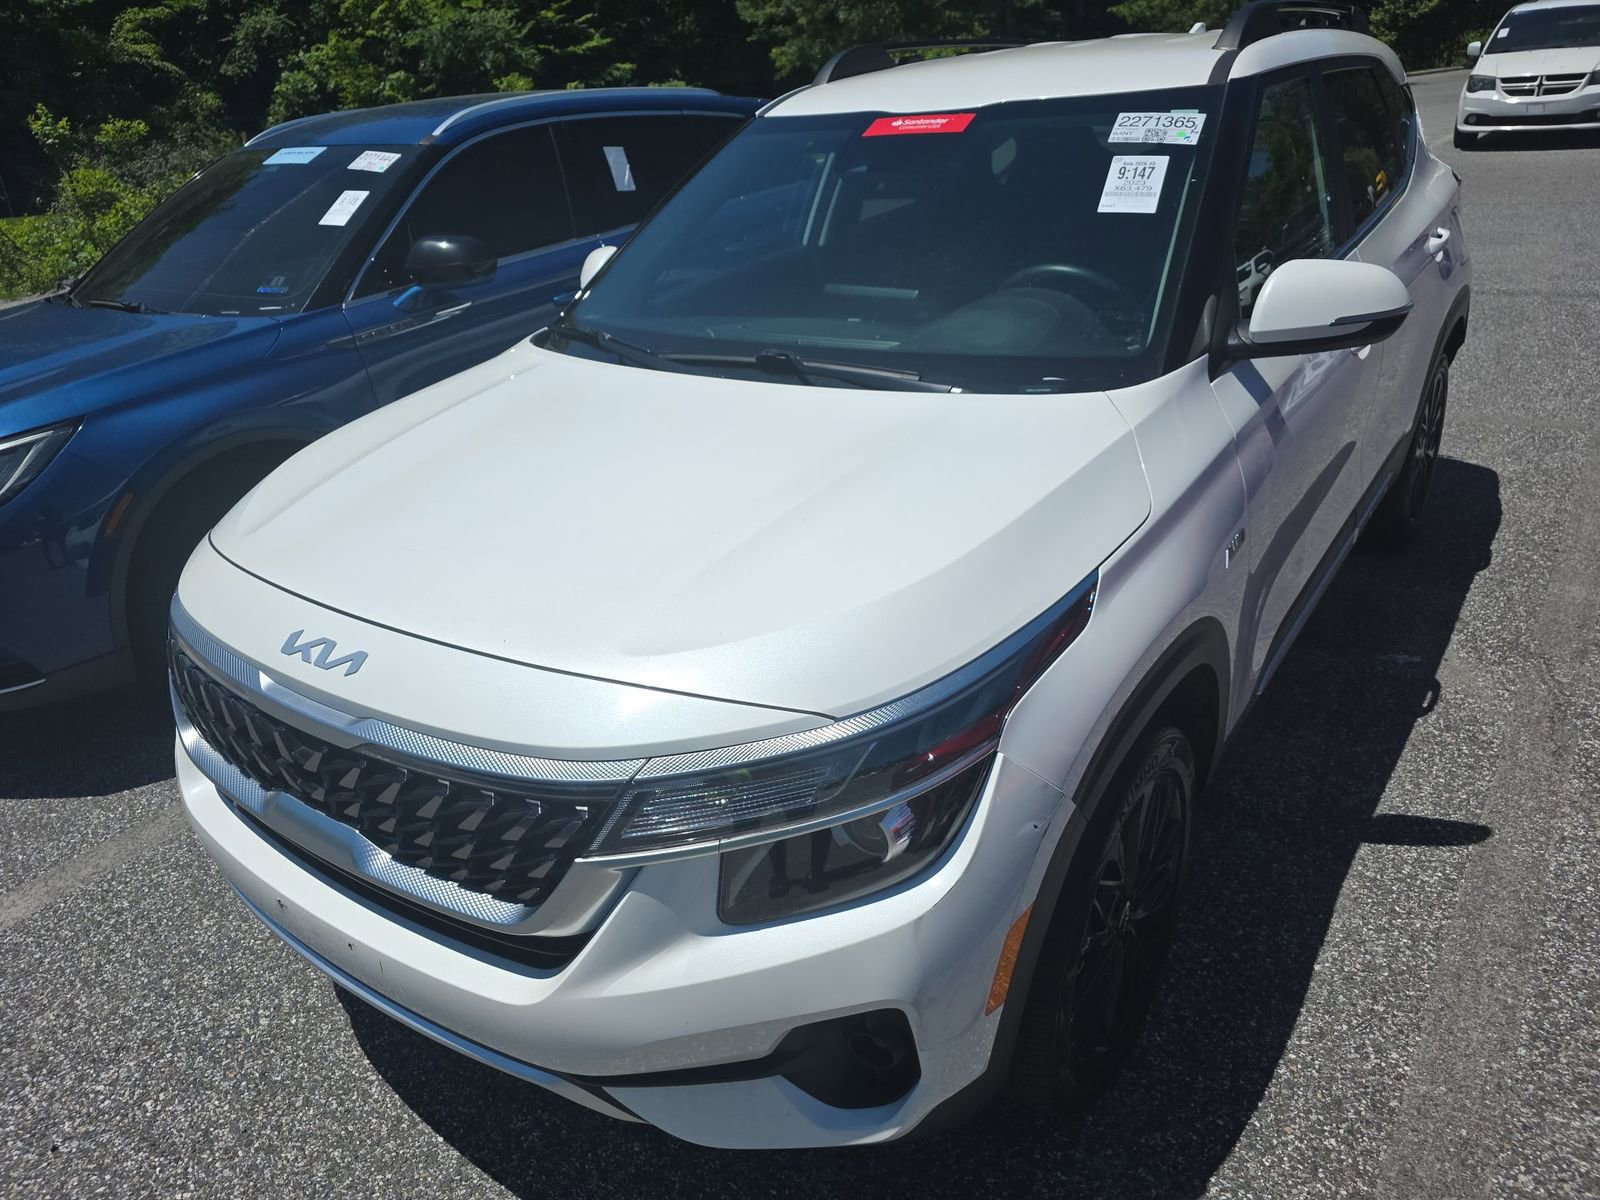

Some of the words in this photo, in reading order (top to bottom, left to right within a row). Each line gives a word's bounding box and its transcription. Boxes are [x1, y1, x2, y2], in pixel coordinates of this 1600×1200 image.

[902, 117, 950, 125] Santander
[1118, 115, 1197, 128] 2271365
[1117, 166, 1156, 180] 9:147
[281, 629, 368, 677] KIA
